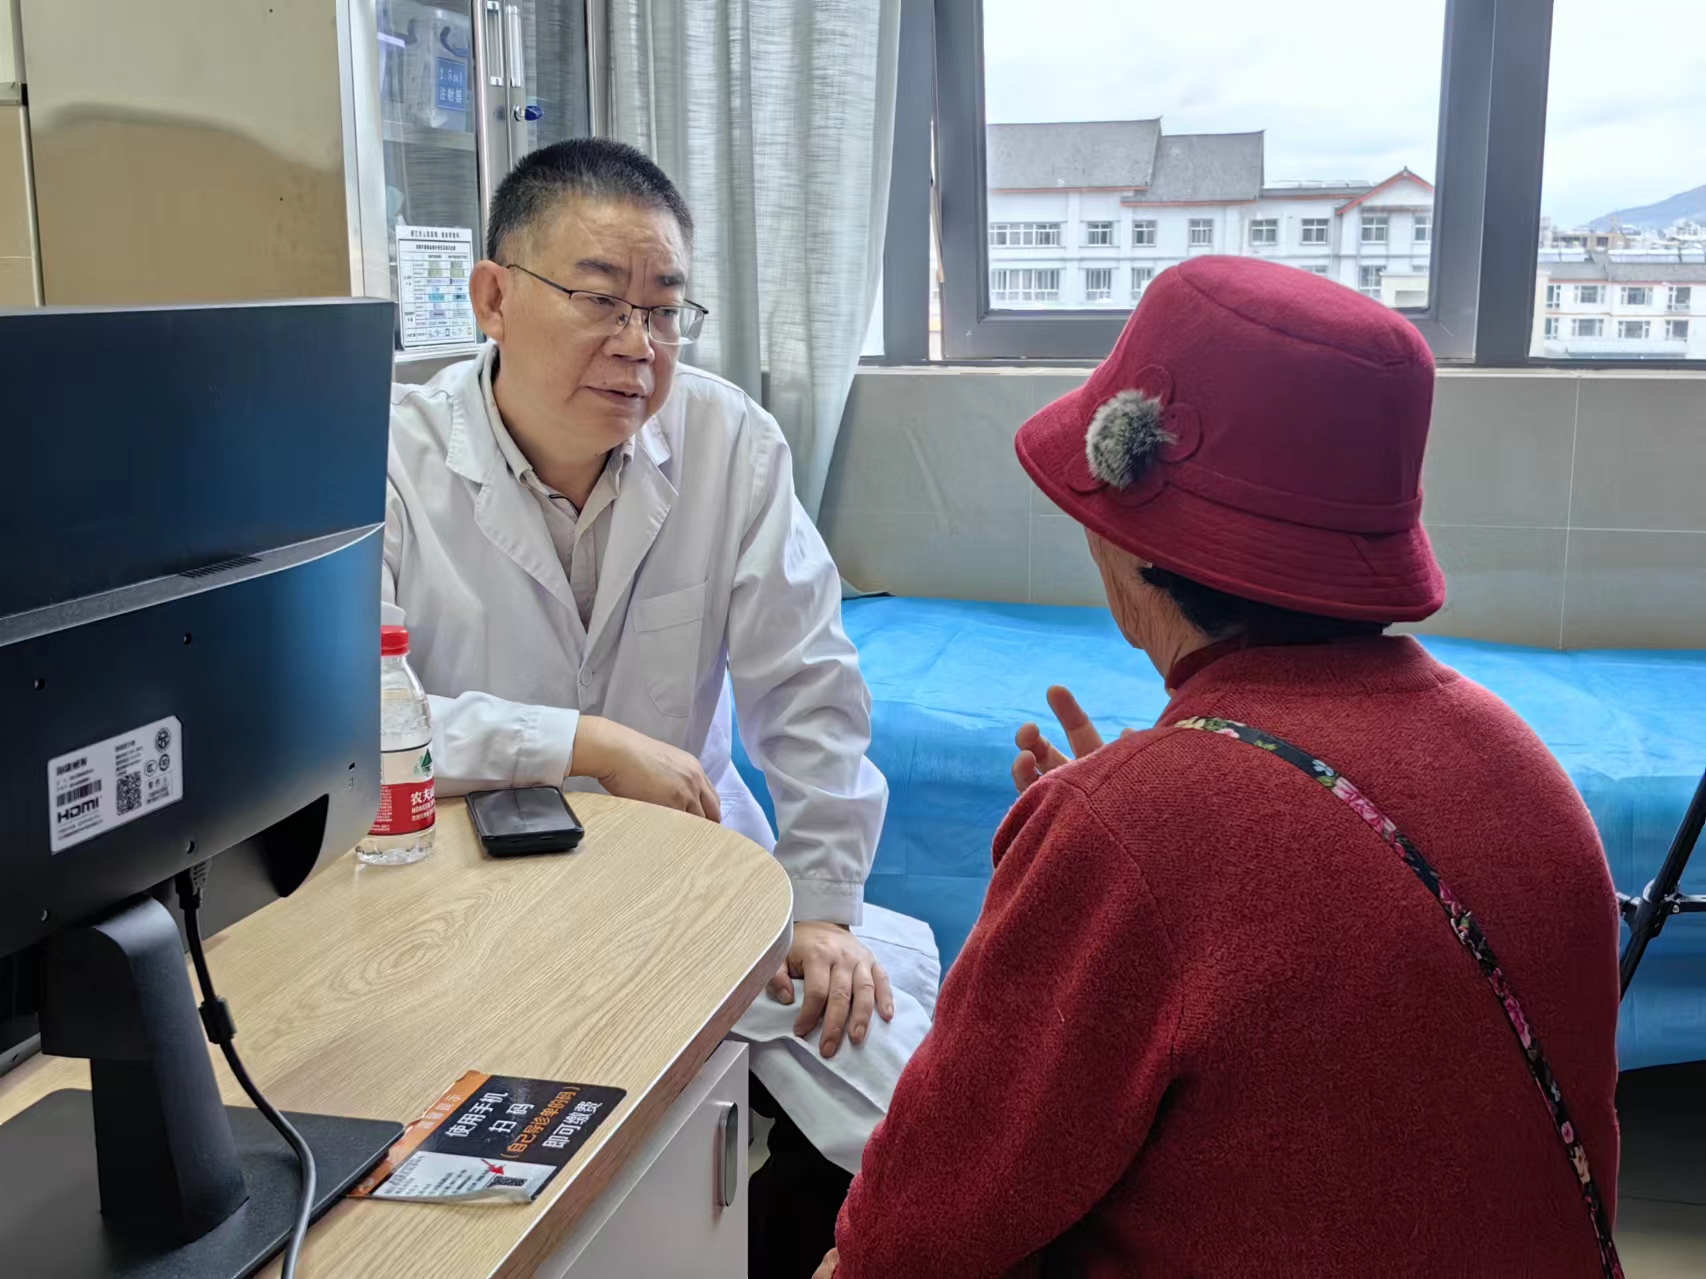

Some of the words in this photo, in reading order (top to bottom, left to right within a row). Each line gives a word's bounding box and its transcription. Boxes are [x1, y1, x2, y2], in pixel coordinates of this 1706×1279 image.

[57, 797, 99, 823] HDMI
[445, 1092, 508, 1138] 使用手机
[541, 1100, 603, 1149] 即可缴费
